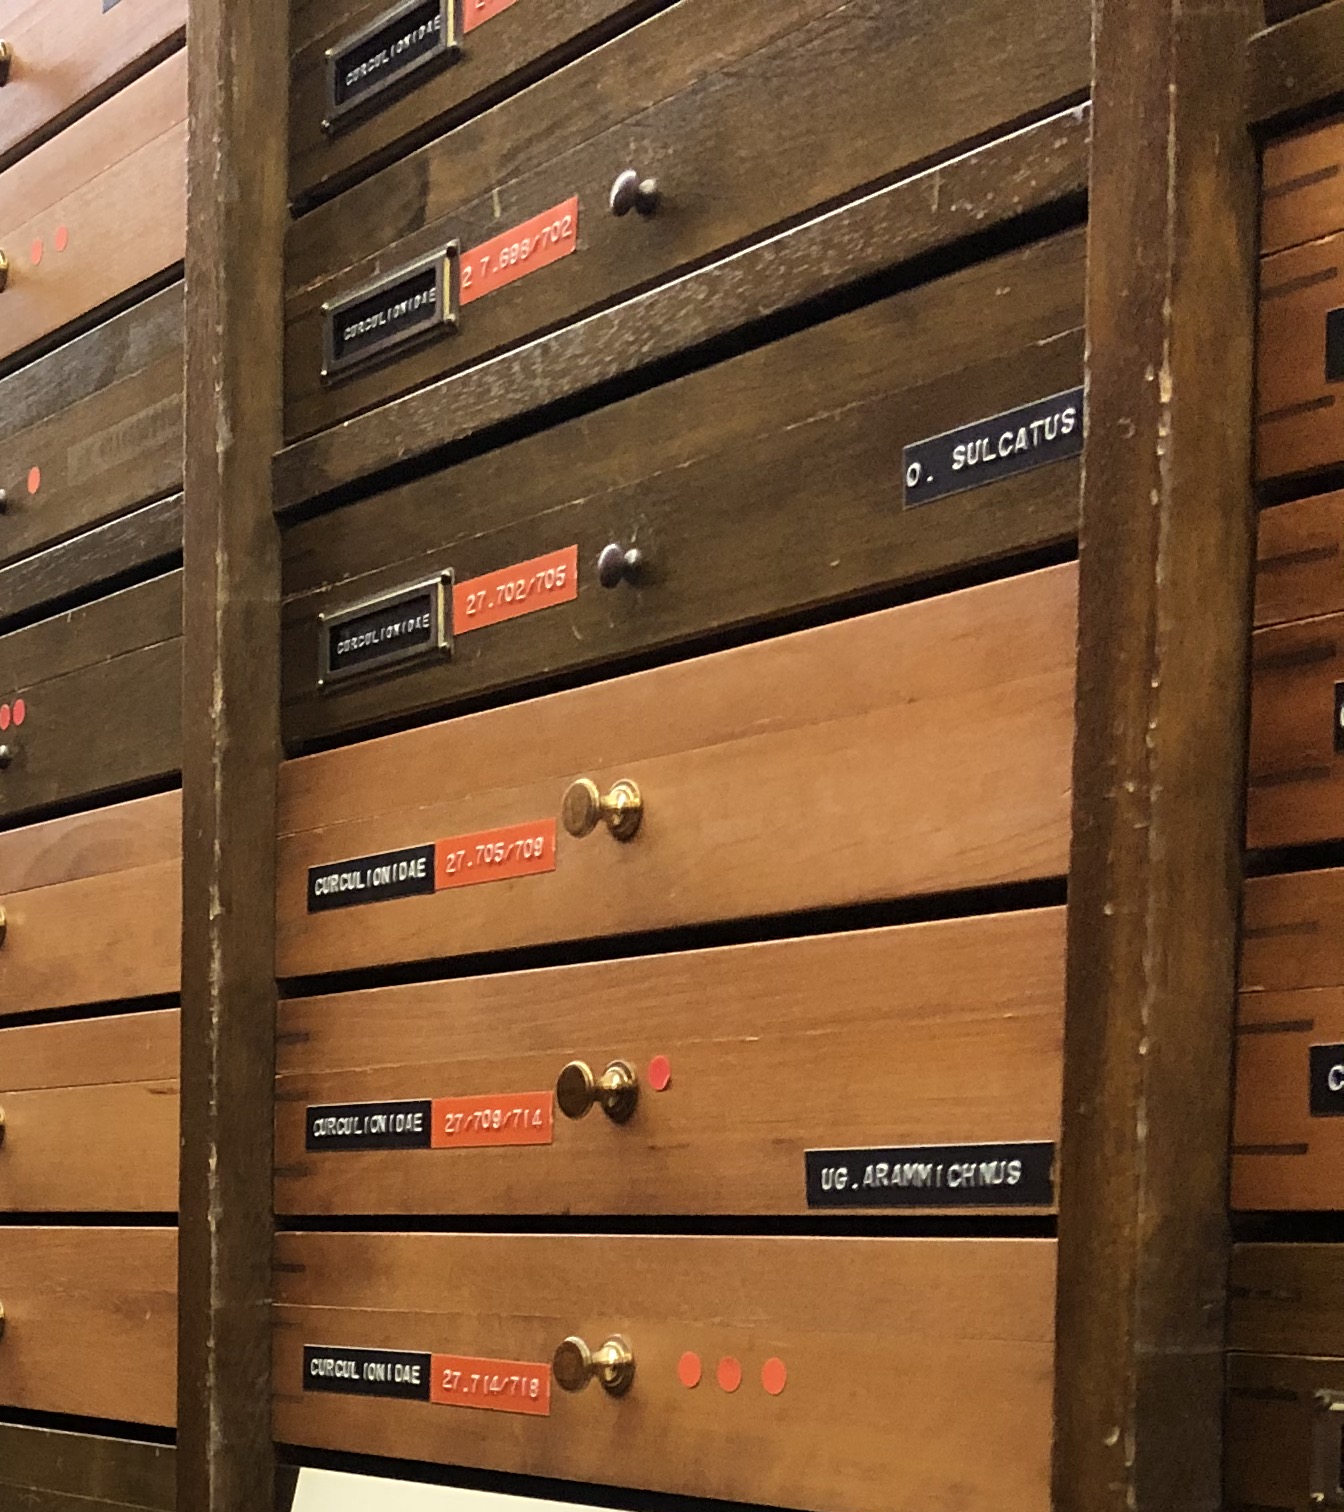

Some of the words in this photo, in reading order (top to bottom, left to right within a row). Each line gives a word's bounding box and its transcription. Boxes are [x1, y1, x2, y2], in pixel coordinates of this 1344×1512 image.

[905, 462, 934, 488] O.
[951, 407, 1077, 470] SULCATUS
[465, 565, 567, 616] 27.702/705
[313, 856, 427, 897] CURCULIONIDAE
[445, 836, 545, 874] 27.705/709
[312, 1112, 424, 1137] CURCULIONIDAE
[444, 1108, 543, 1134] 27/709/714
[309, 1357, 421, 1385] CURCULIONIDAE
[441, 1369, 541, 1399] 27.714/718
